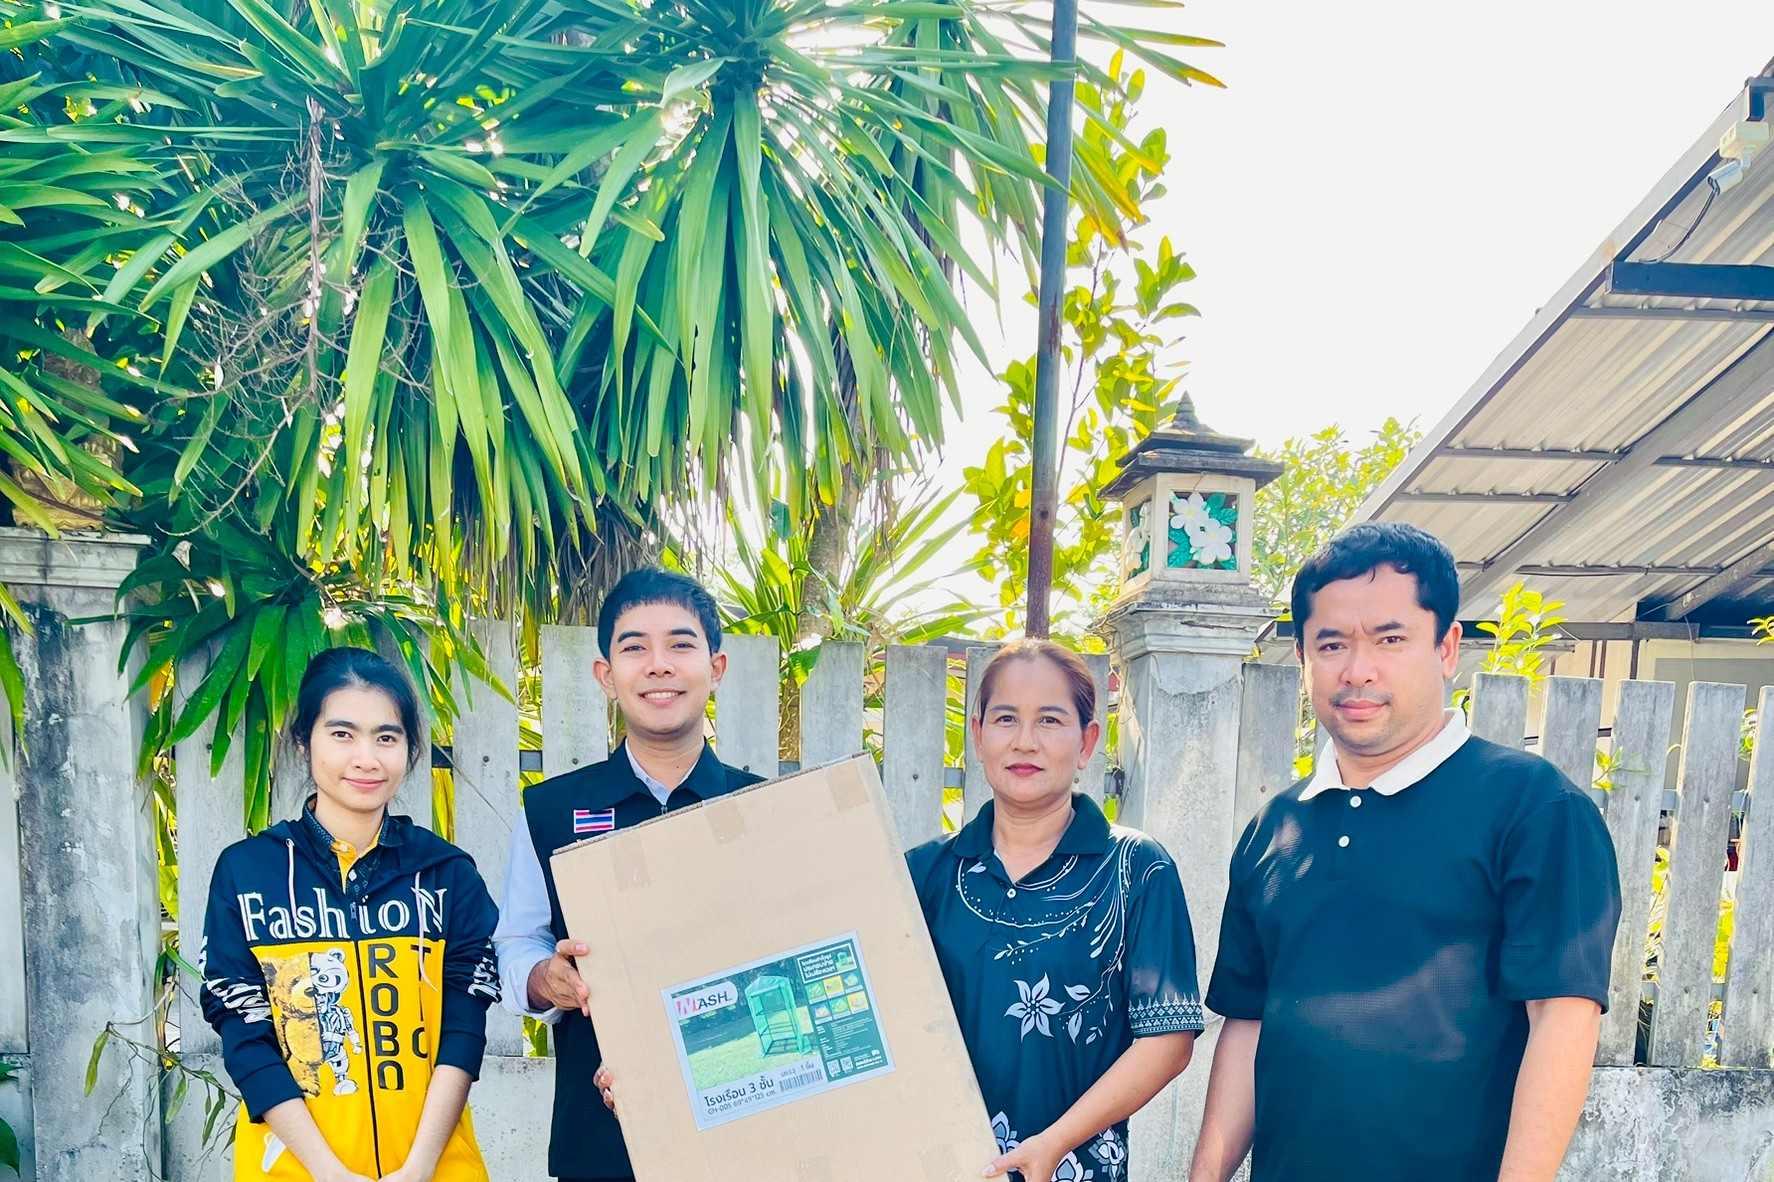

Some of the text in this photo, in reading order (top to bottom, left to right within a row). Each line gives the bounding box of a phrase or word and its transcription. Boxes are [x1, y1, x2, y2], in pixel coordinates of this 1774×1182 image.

[704, 1075, 775, 1107] โรงเรือน 3 ชั้น
[707, 1103, 733, 1115] GH-005
[766, 1089, 776, 1098] cm
